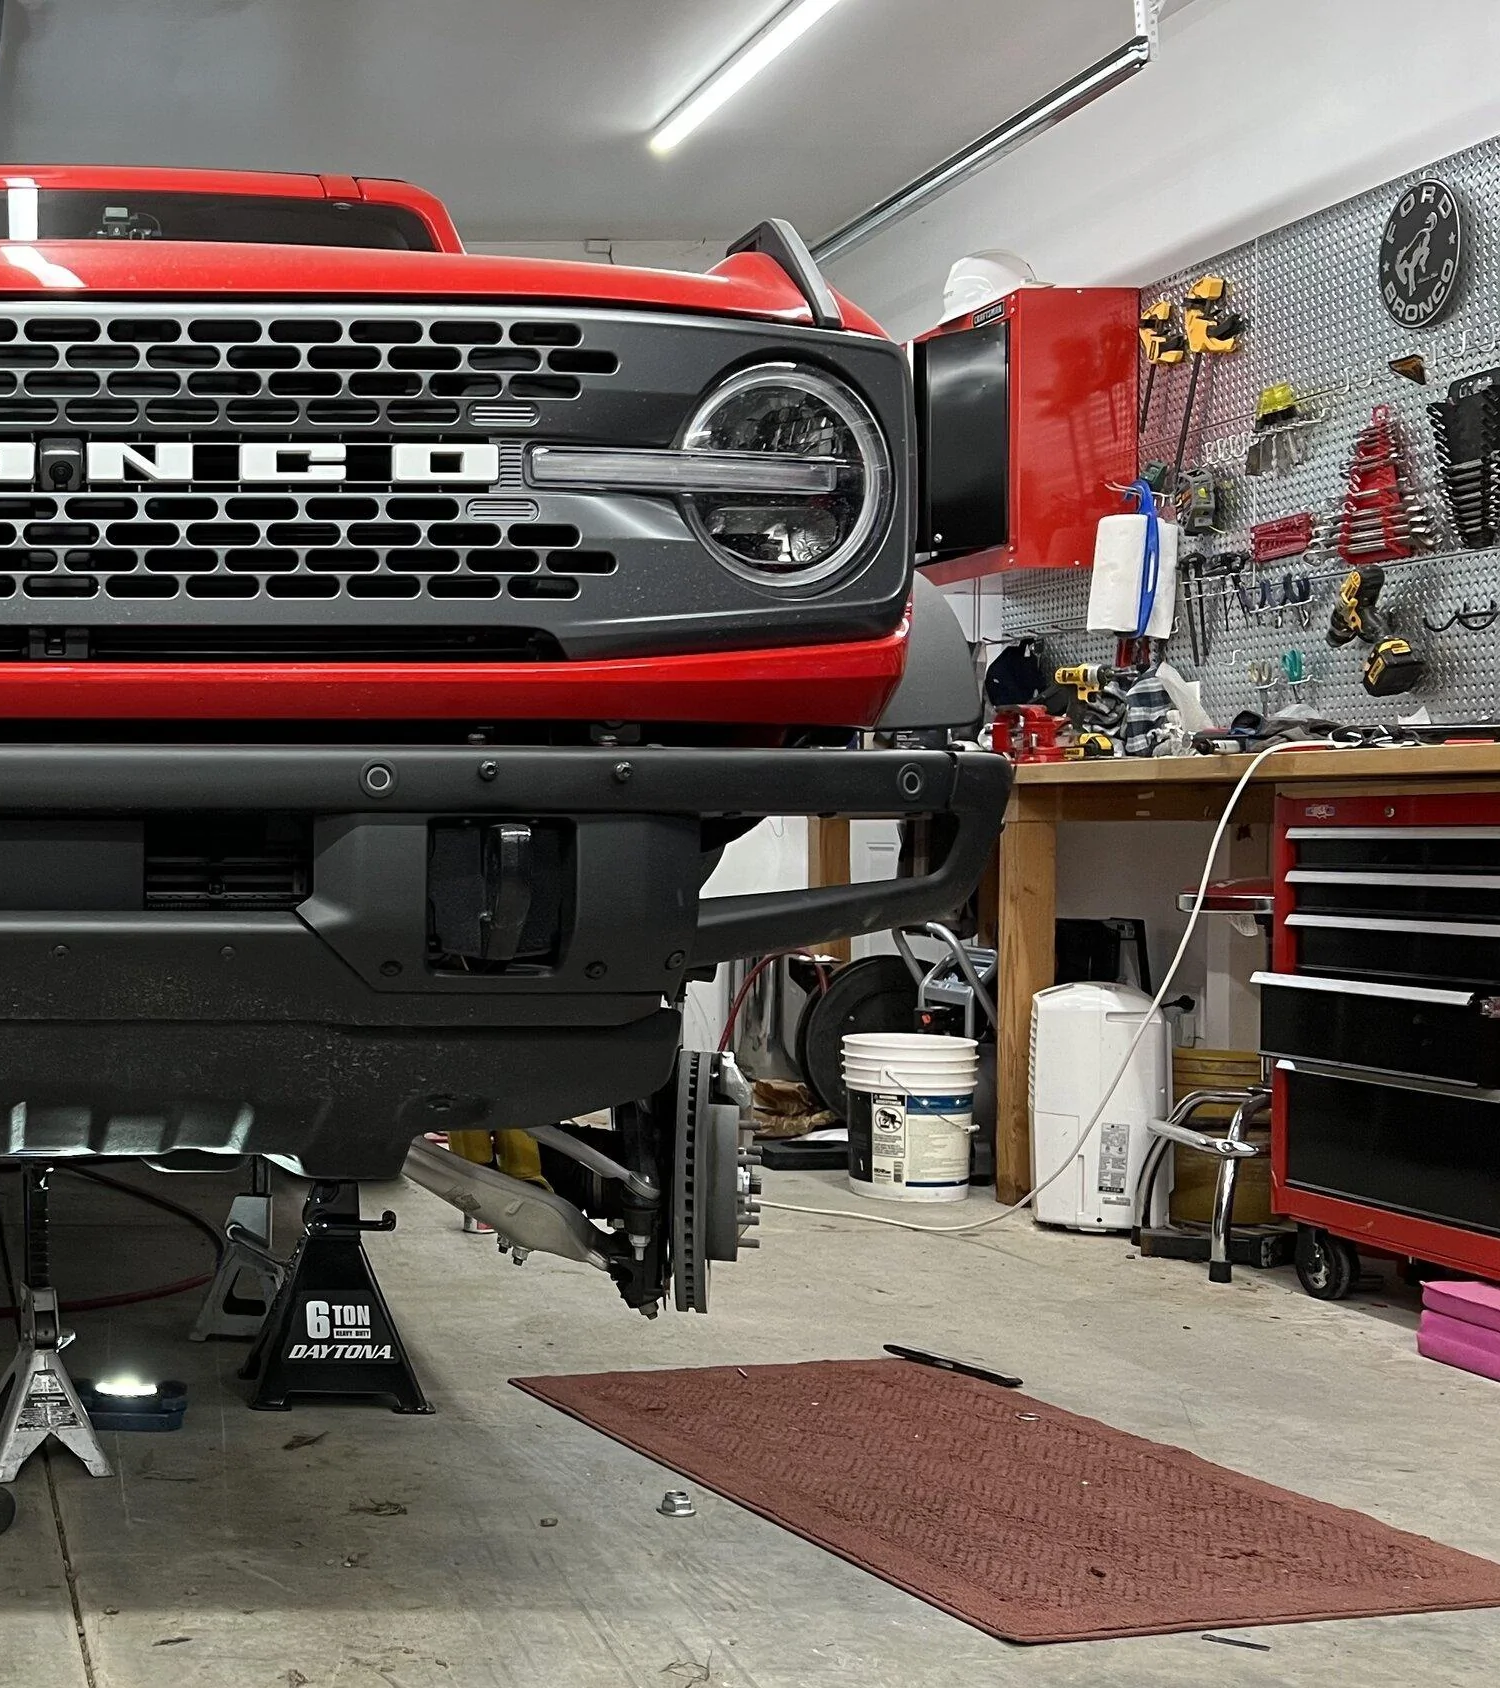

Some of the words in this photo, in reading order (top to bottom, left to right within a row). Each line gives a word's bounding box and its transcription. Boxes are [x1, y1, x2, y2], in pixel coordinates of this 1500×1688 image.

[1385, 186, 1453, 245] FORD
[1384, 258, 1454, 322] BRONCO
[306, 1300, 330, 1339] 6
[332, 1305, 370, 1326] TON
[288, 1344, 393, 1359] DAYTONA
